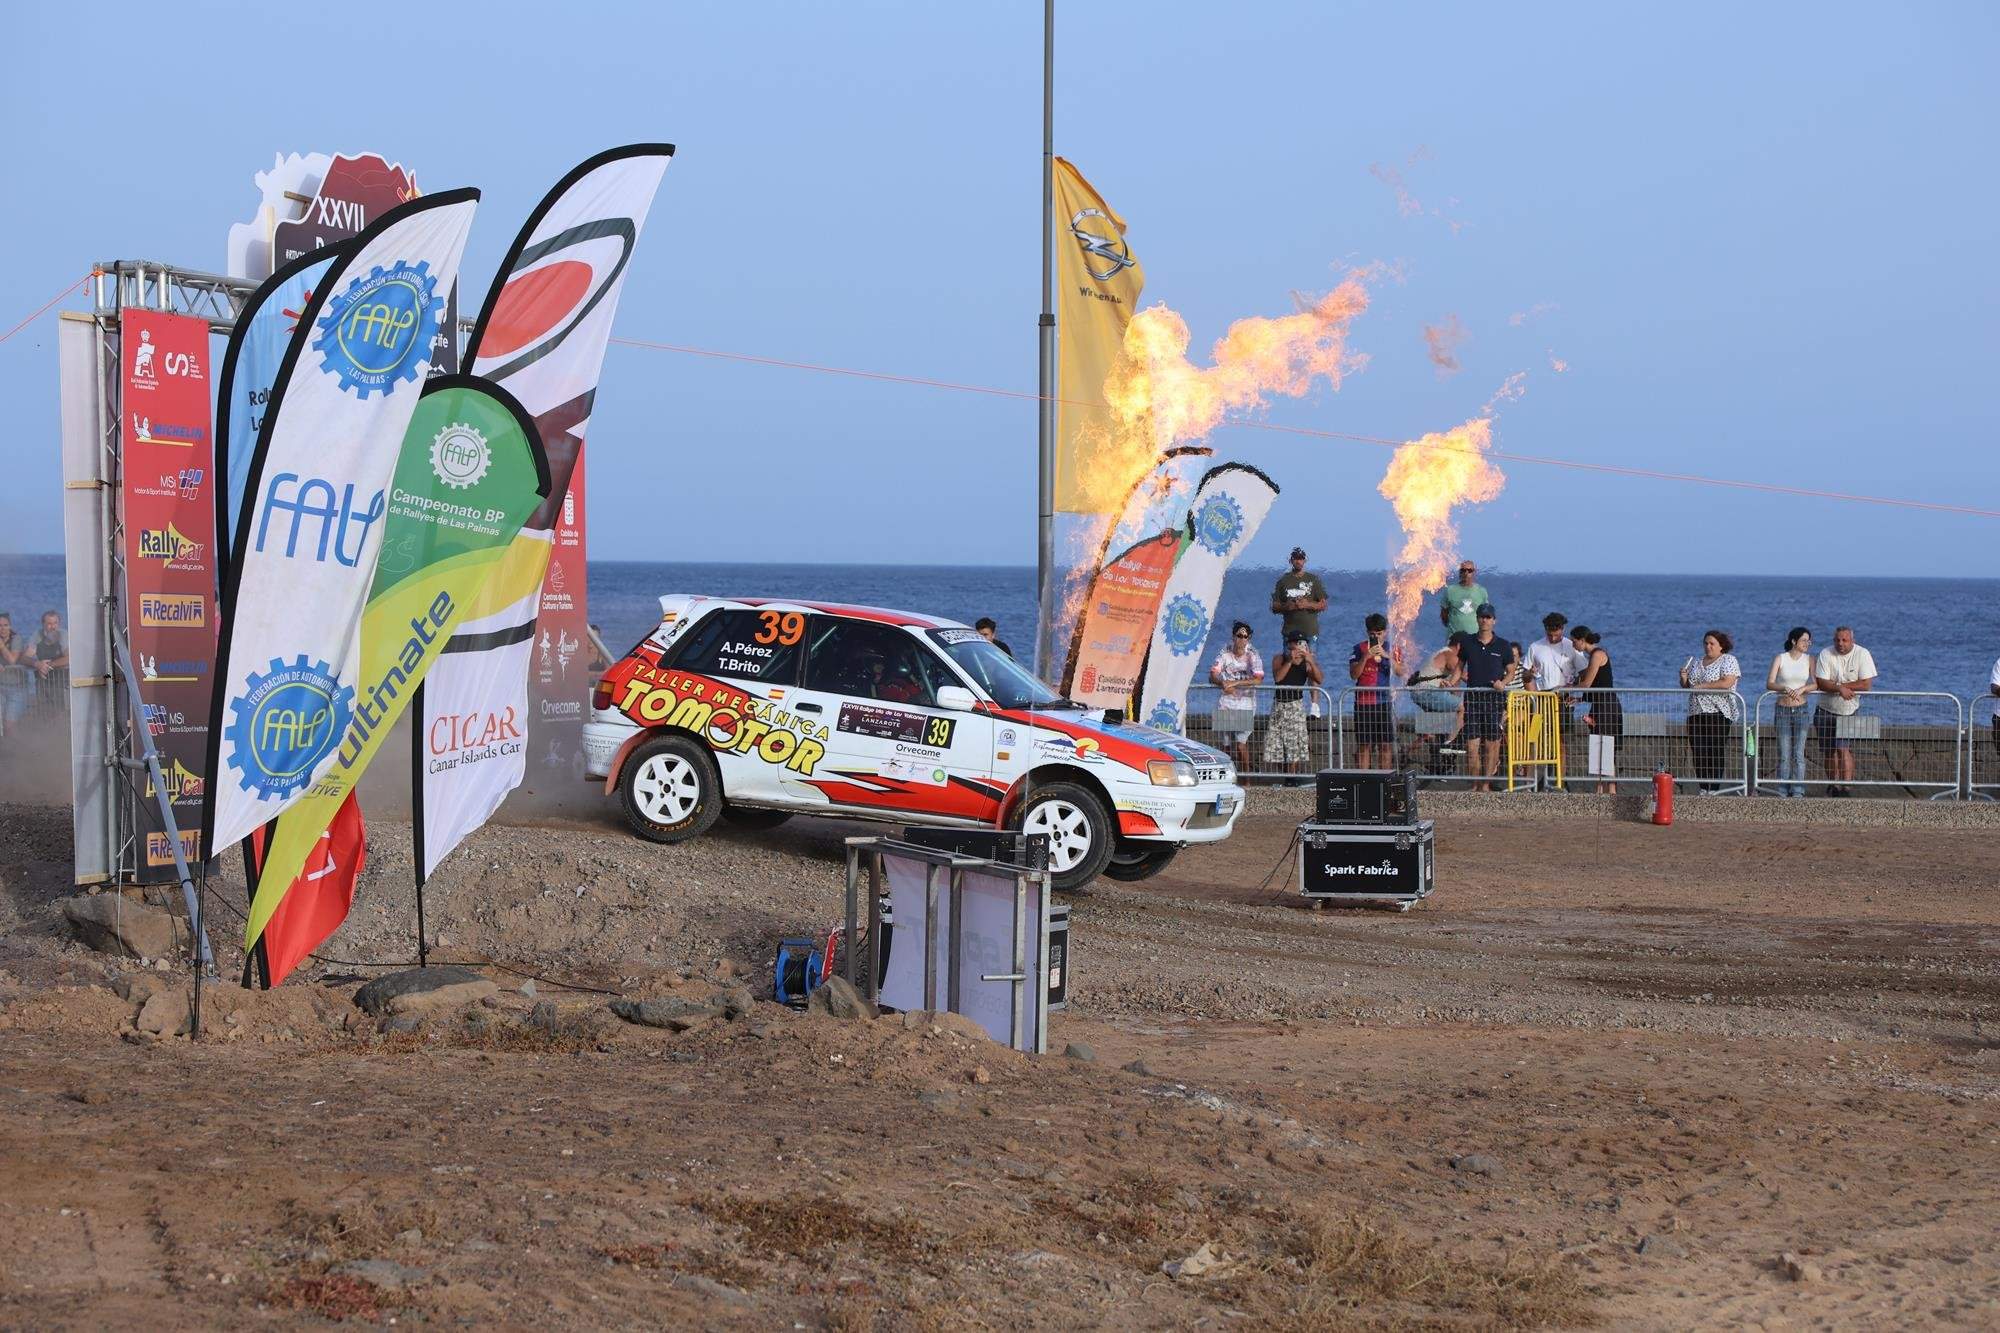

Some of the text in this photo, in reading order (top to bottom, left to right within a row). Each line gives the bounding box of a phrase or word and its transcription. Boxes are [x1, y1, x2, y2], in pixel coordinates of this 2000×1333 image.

[317, 196, 365, 232] XXVII
[348, 367, 386, 385] LAS PALMAS
[392, 488, 505, 523] Campeonato BP
[389, 505, 501, 536] de Rallyes de Las Palmas
[141, 528, 204, 560] Rallycar
[153, 600, 193, 620] Recalvi
[754, 610, 805, 645] 39
[720, 641, 773, 658] A.Pérez
[718, 657, 760, 673] T.Brito
[250, 672, 290, 705] FEDERACIÓN
[291, 672, 300, 681] DE
[634, 663, 830, 742] TALLER MECÁNICA
[541, 699, 581, 715] Orvecame
[430, 705, 521, 755] CICAR
[618, 678, 826, 776] TOMOTOR
[861, 717, 901, 728] LANZAROTE
[928, 718, 950, 746] 39
[429, 758, 460, 774] Canar
[500, 742, 521, 756] Car
[896, 743, 941, 758] Orvecame
[266, 777, 280, 786] LAS
[1325, 860, 1399, 877] Spark Fabrica
